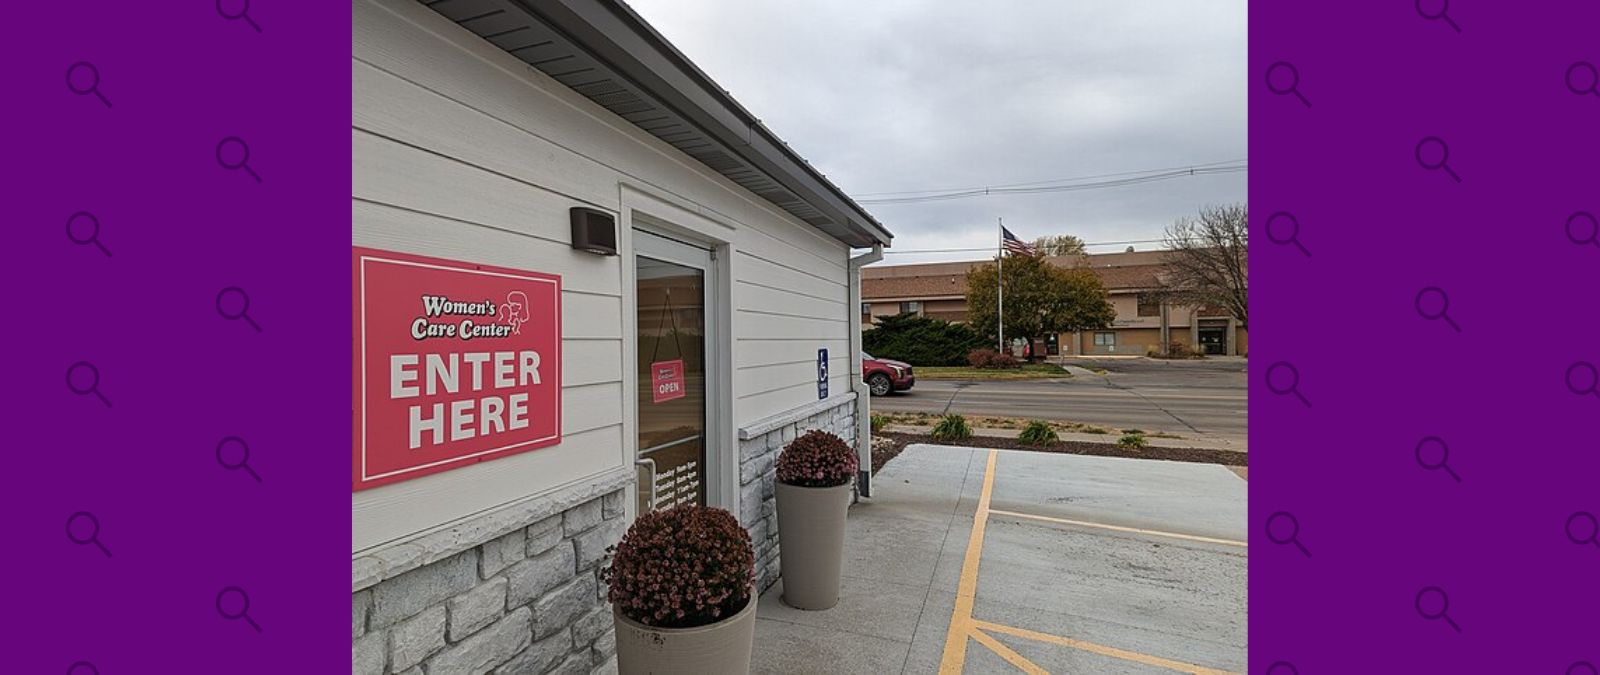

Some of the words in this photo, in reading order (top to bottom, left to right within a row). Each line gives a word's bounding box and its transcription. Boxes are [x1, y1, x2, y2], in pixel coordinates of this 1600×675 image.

[421, 295, 496, 316] Women's
[411, 318, 456, 339] Care
[459, 320, 511, 339] Center
[391, 351, 541, 399] ENTER
[659, 382, 679, 394] OPEN
[410, 393, 529, 449] HERE
